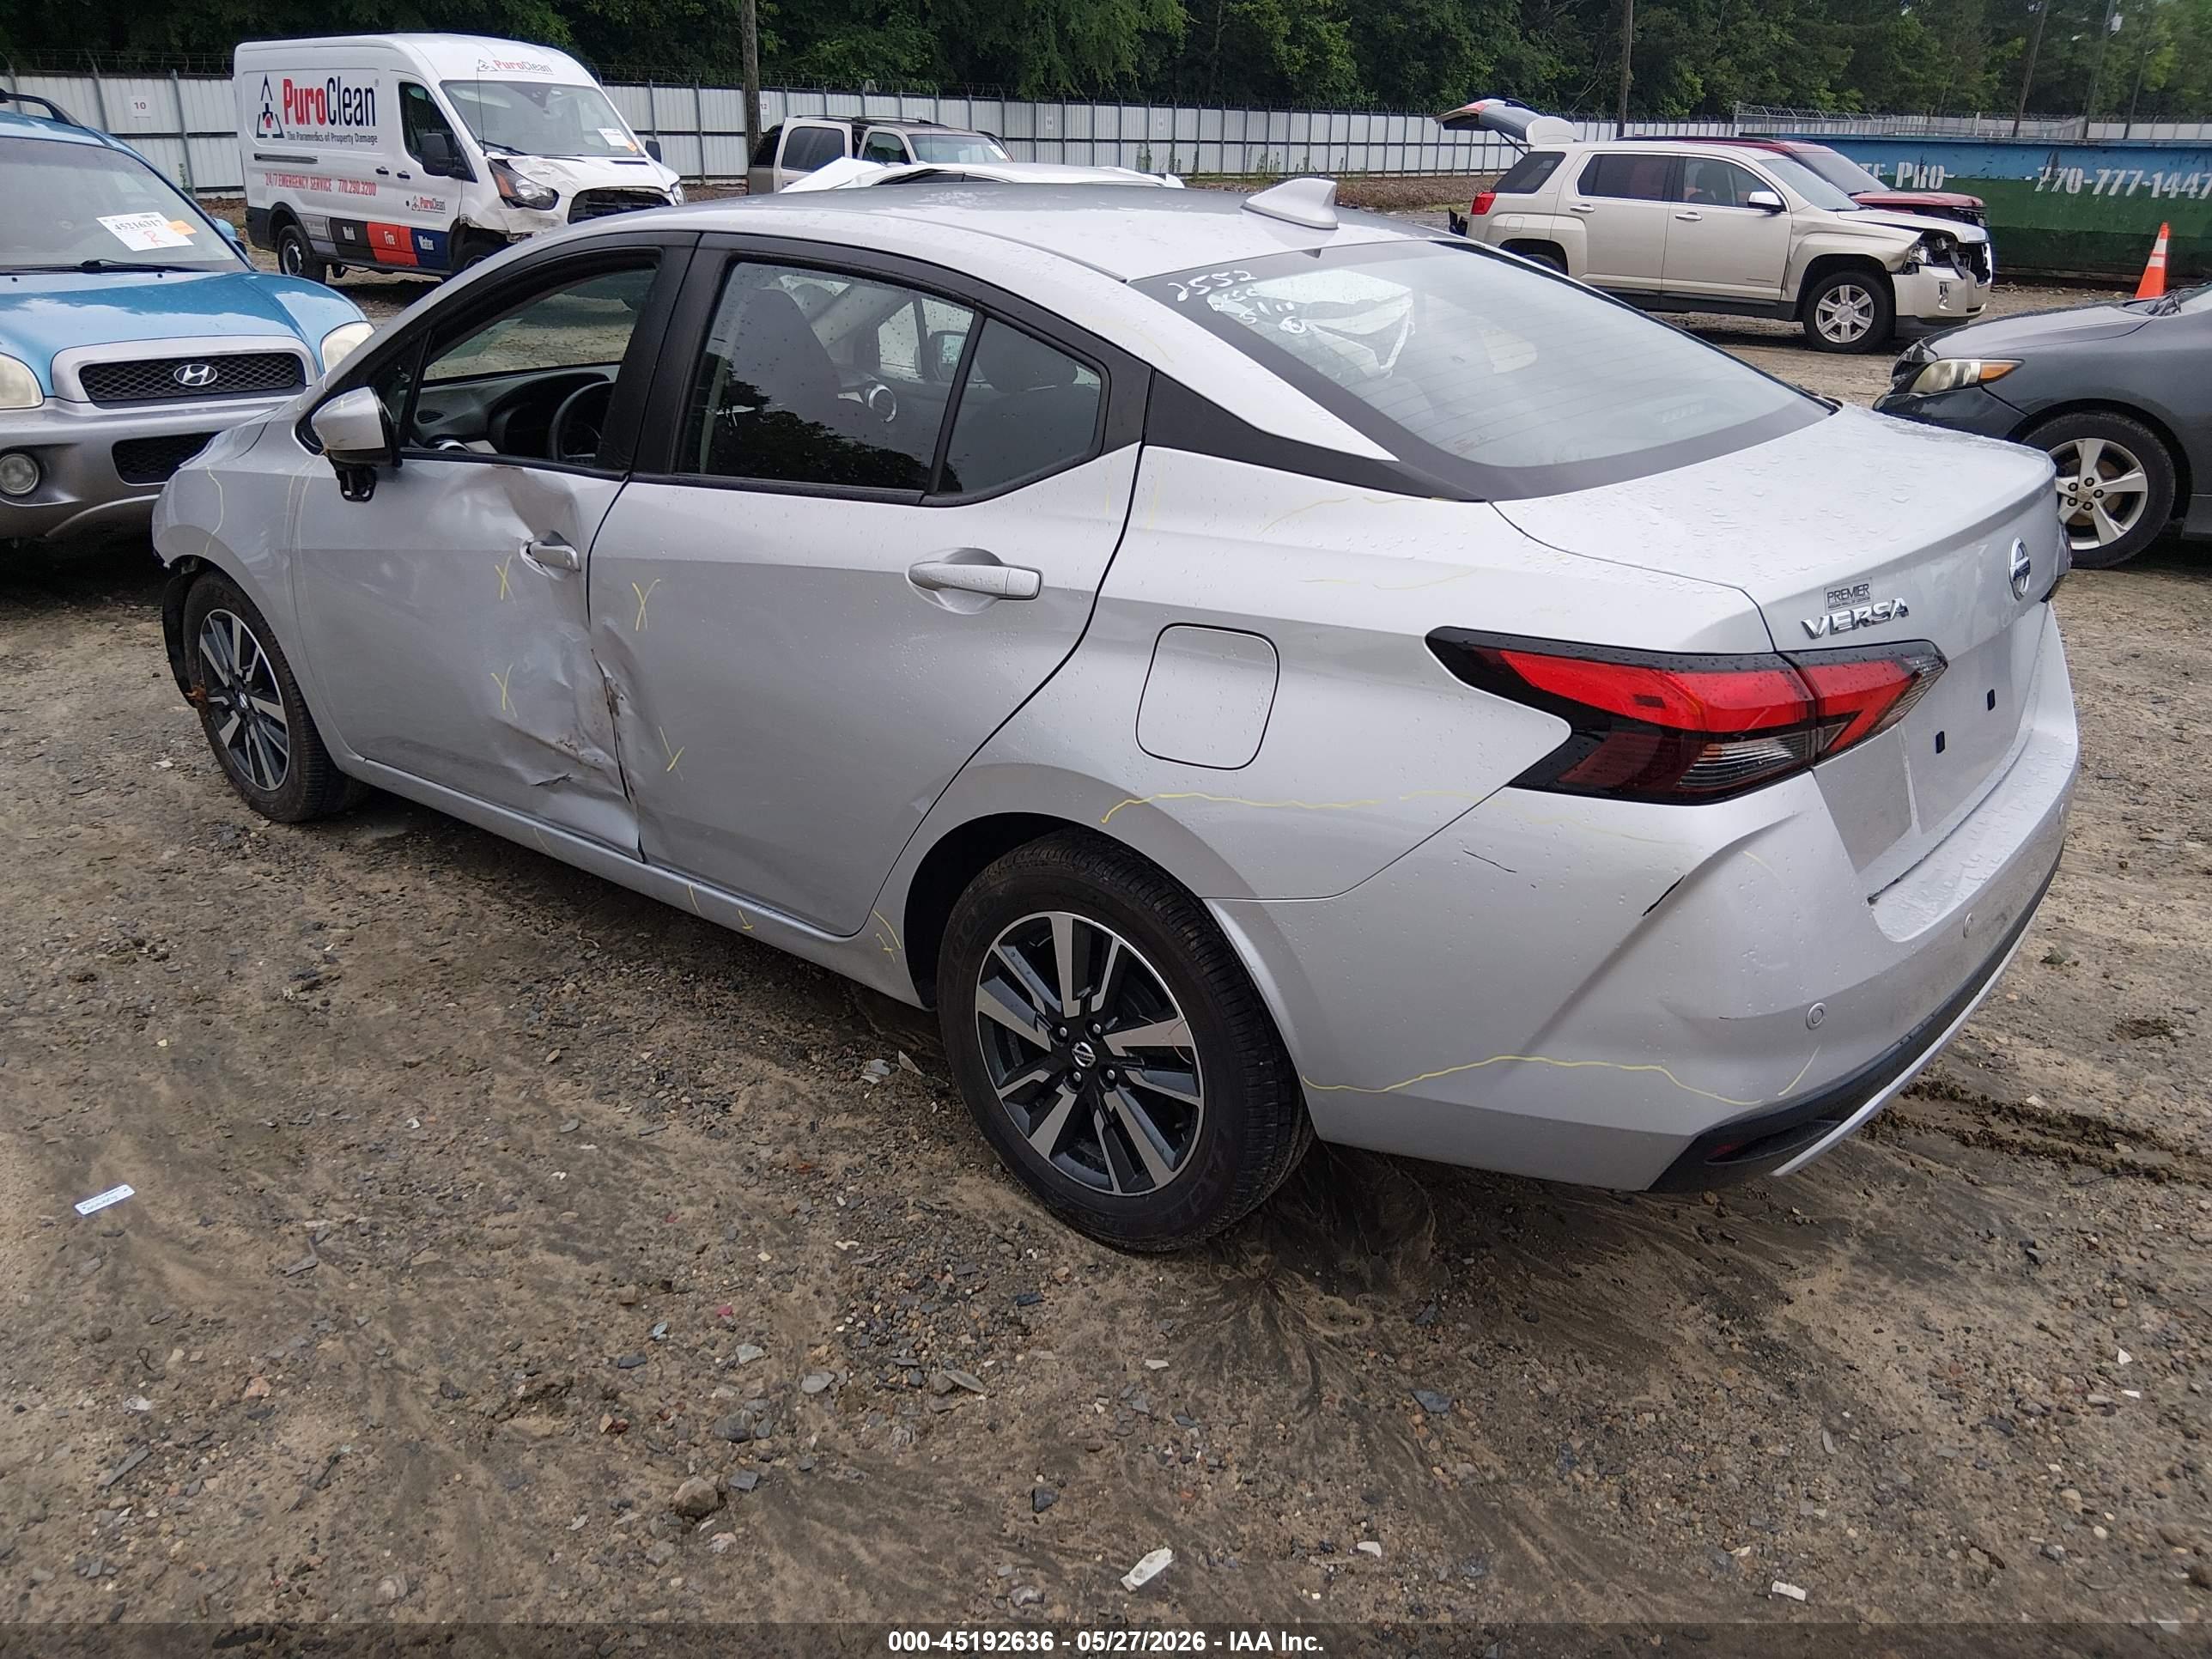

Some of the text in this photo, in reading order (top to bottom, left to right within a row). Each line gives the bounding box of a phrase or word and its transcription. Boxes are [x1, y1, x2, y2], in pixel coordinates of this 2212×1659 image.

[493, 59, 552, 72] PuroClean
[133, 101, 146, 110] 10
[283, 76, 376, 127] PuroClean
[331, 132, 354, 144] Property
[355, 133, 378, 146] Damage
[310, 176, 331, 192] SERVICE
[1826, 583, 1870, 605] PREMIER
[1801, 598, 1909, 640] VERSA
